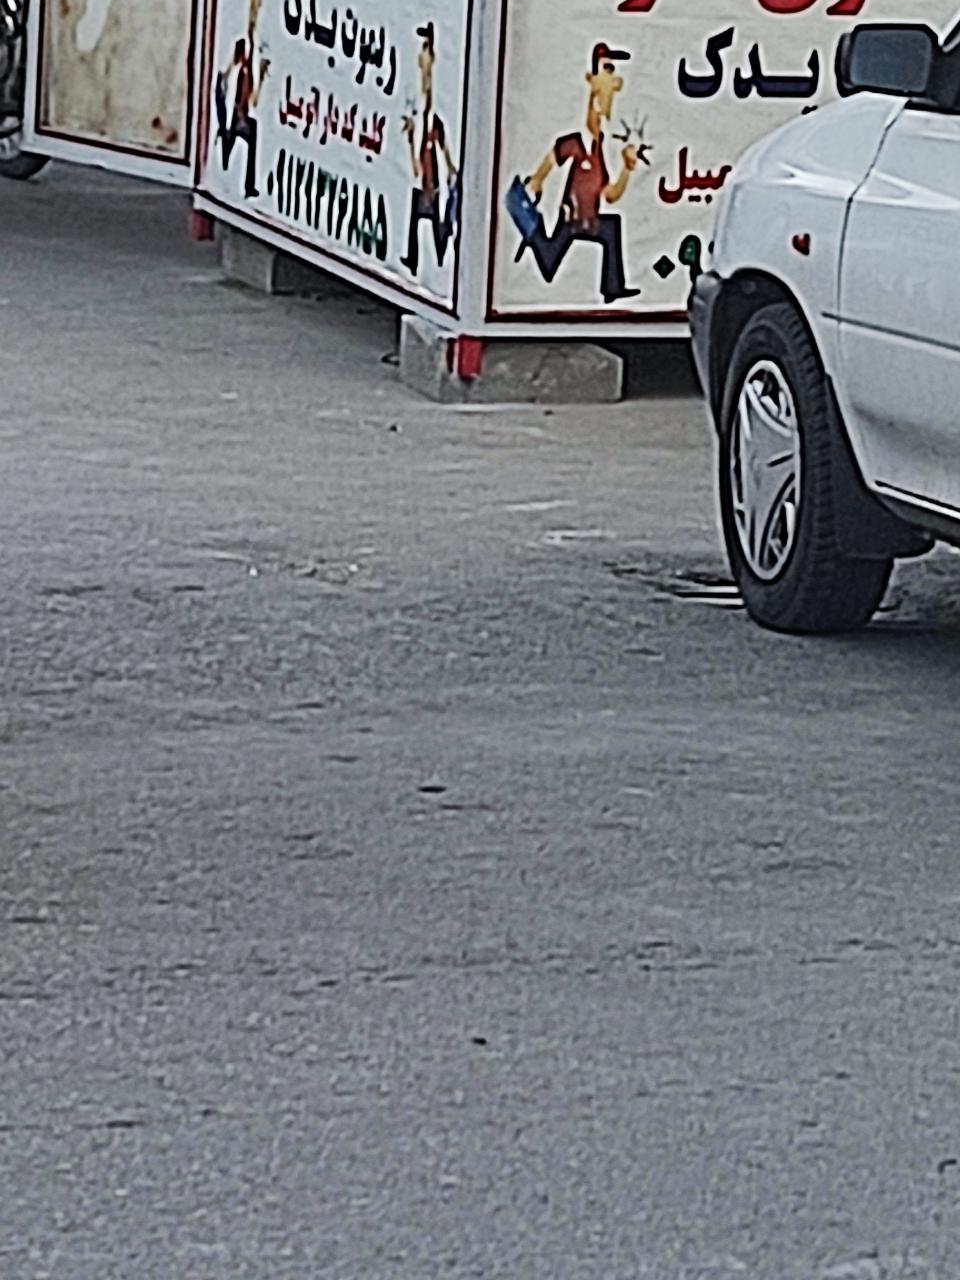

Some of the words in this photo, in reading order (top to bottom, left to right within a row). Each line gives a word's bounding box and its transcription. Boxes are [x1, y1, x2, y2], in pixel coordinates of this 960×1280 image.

[341, 7, 397, 97] ریموت
[676, 25, 820, 115] یدک
[358, 111, 387, 164] کلید
